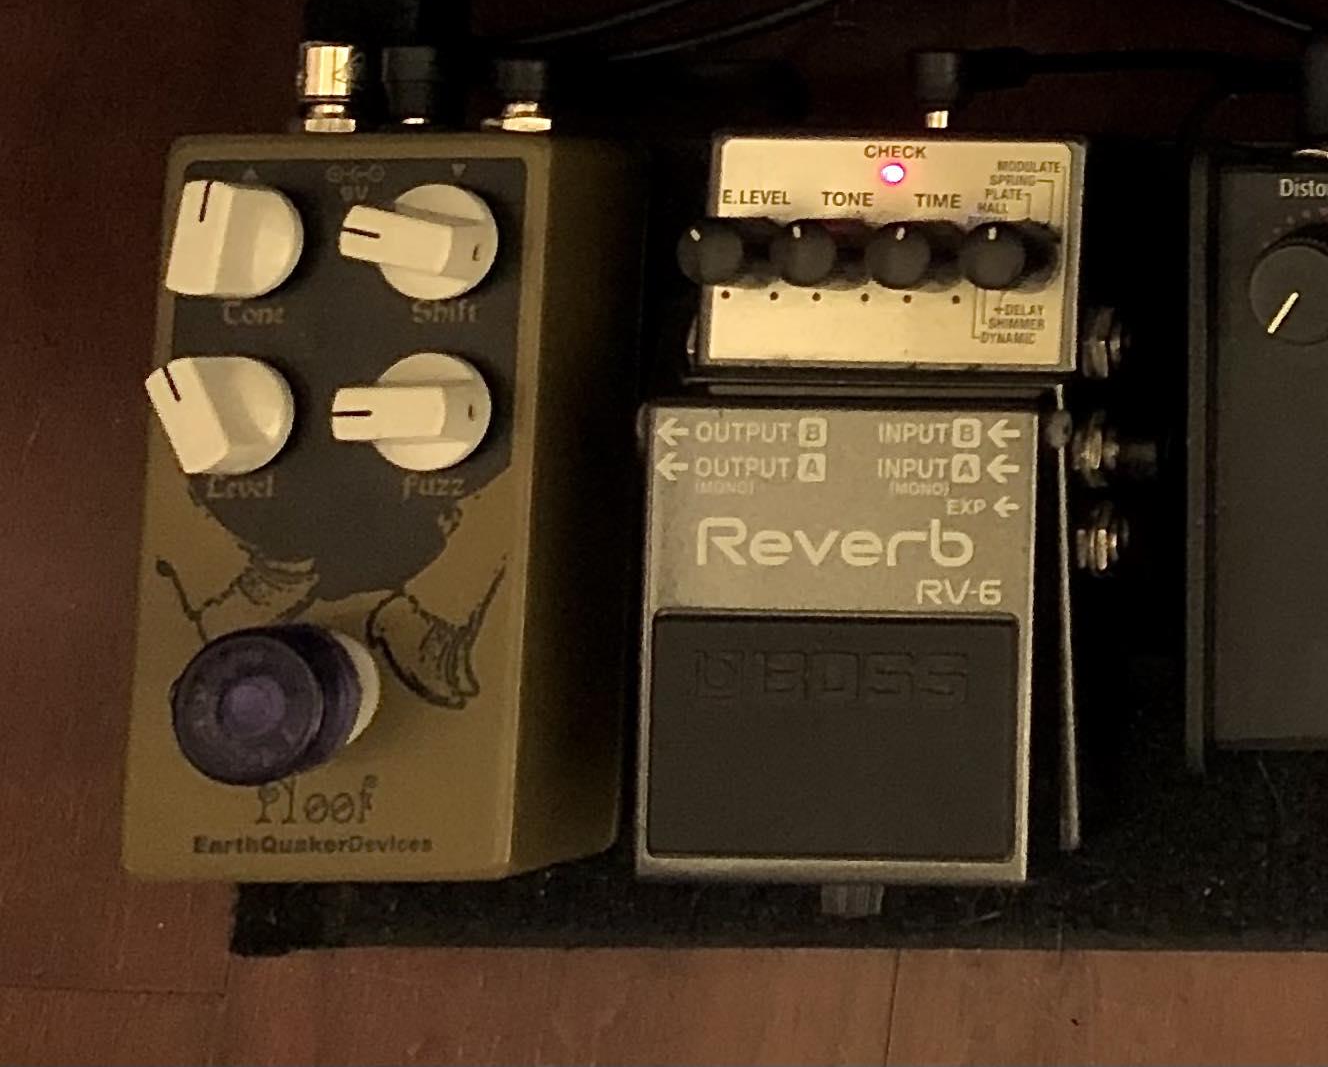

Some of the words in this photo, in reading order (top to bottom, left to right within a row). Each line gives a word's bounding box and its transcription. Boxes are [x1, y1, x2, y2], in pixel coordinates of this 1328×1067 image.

[864, 145, 926, 159] CHECK
[997, 161, 1061, 172] MODULATE
[723, 190, 791, 205] E.LEVEL
[822, 192, 874, 207] TONE
[915, 194, 961, 208] TIME
[985, 188, 1022, 200] PLATE
[223, 306, 285, 325] Tone
[412, 303, 478, 324] Shift
[695, 423, 792, 444] OUTPUT
[879, 423, 947, 444] INPUT
[694, 458, 791, 478] OUTPUT
[877, 459, 947, 479] INPUT
[206, 477, 275, 498] Level
[946, 500, 986, 516] EXP
[697, 517, 975, 567] Reverb
[916, 580, 1002, 605] RV-6
[194, 835, 432, 854] EarthQuakerDevices
